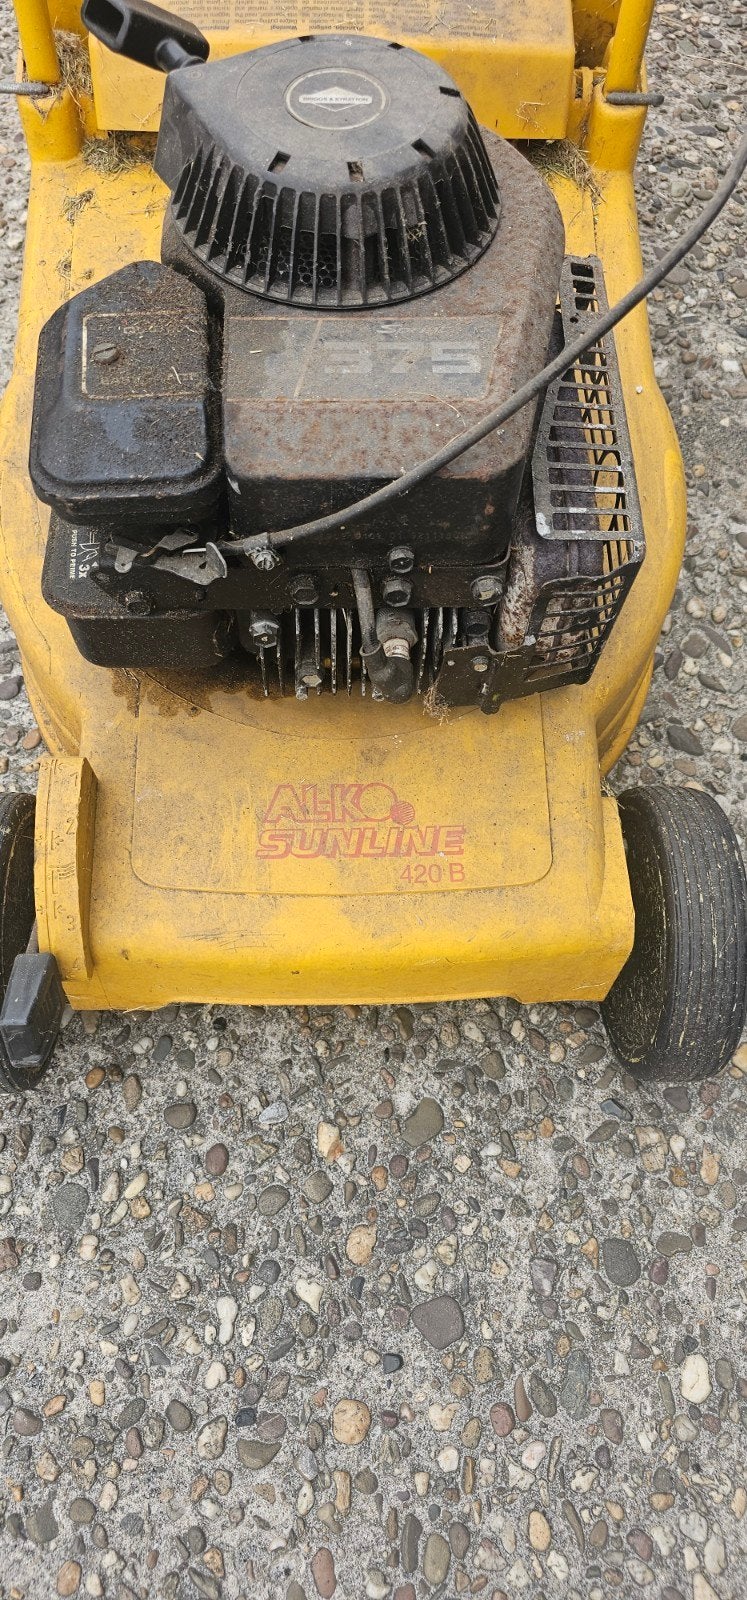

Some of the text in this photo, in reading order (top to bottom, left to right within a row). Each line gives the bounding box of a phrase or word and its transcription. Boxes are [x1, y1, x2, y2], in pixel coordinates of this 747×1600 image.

[323, 341, 482, 373] 375
[70, 548, 77, 558] TO
[79, 564, 90, 579] 3x
[65, 816, 76, 836] 2
[255, 825, 465, 859] SUNLINE
[400, 863, 465, 884] 420 B
[66, 914, 77, 932] 3
